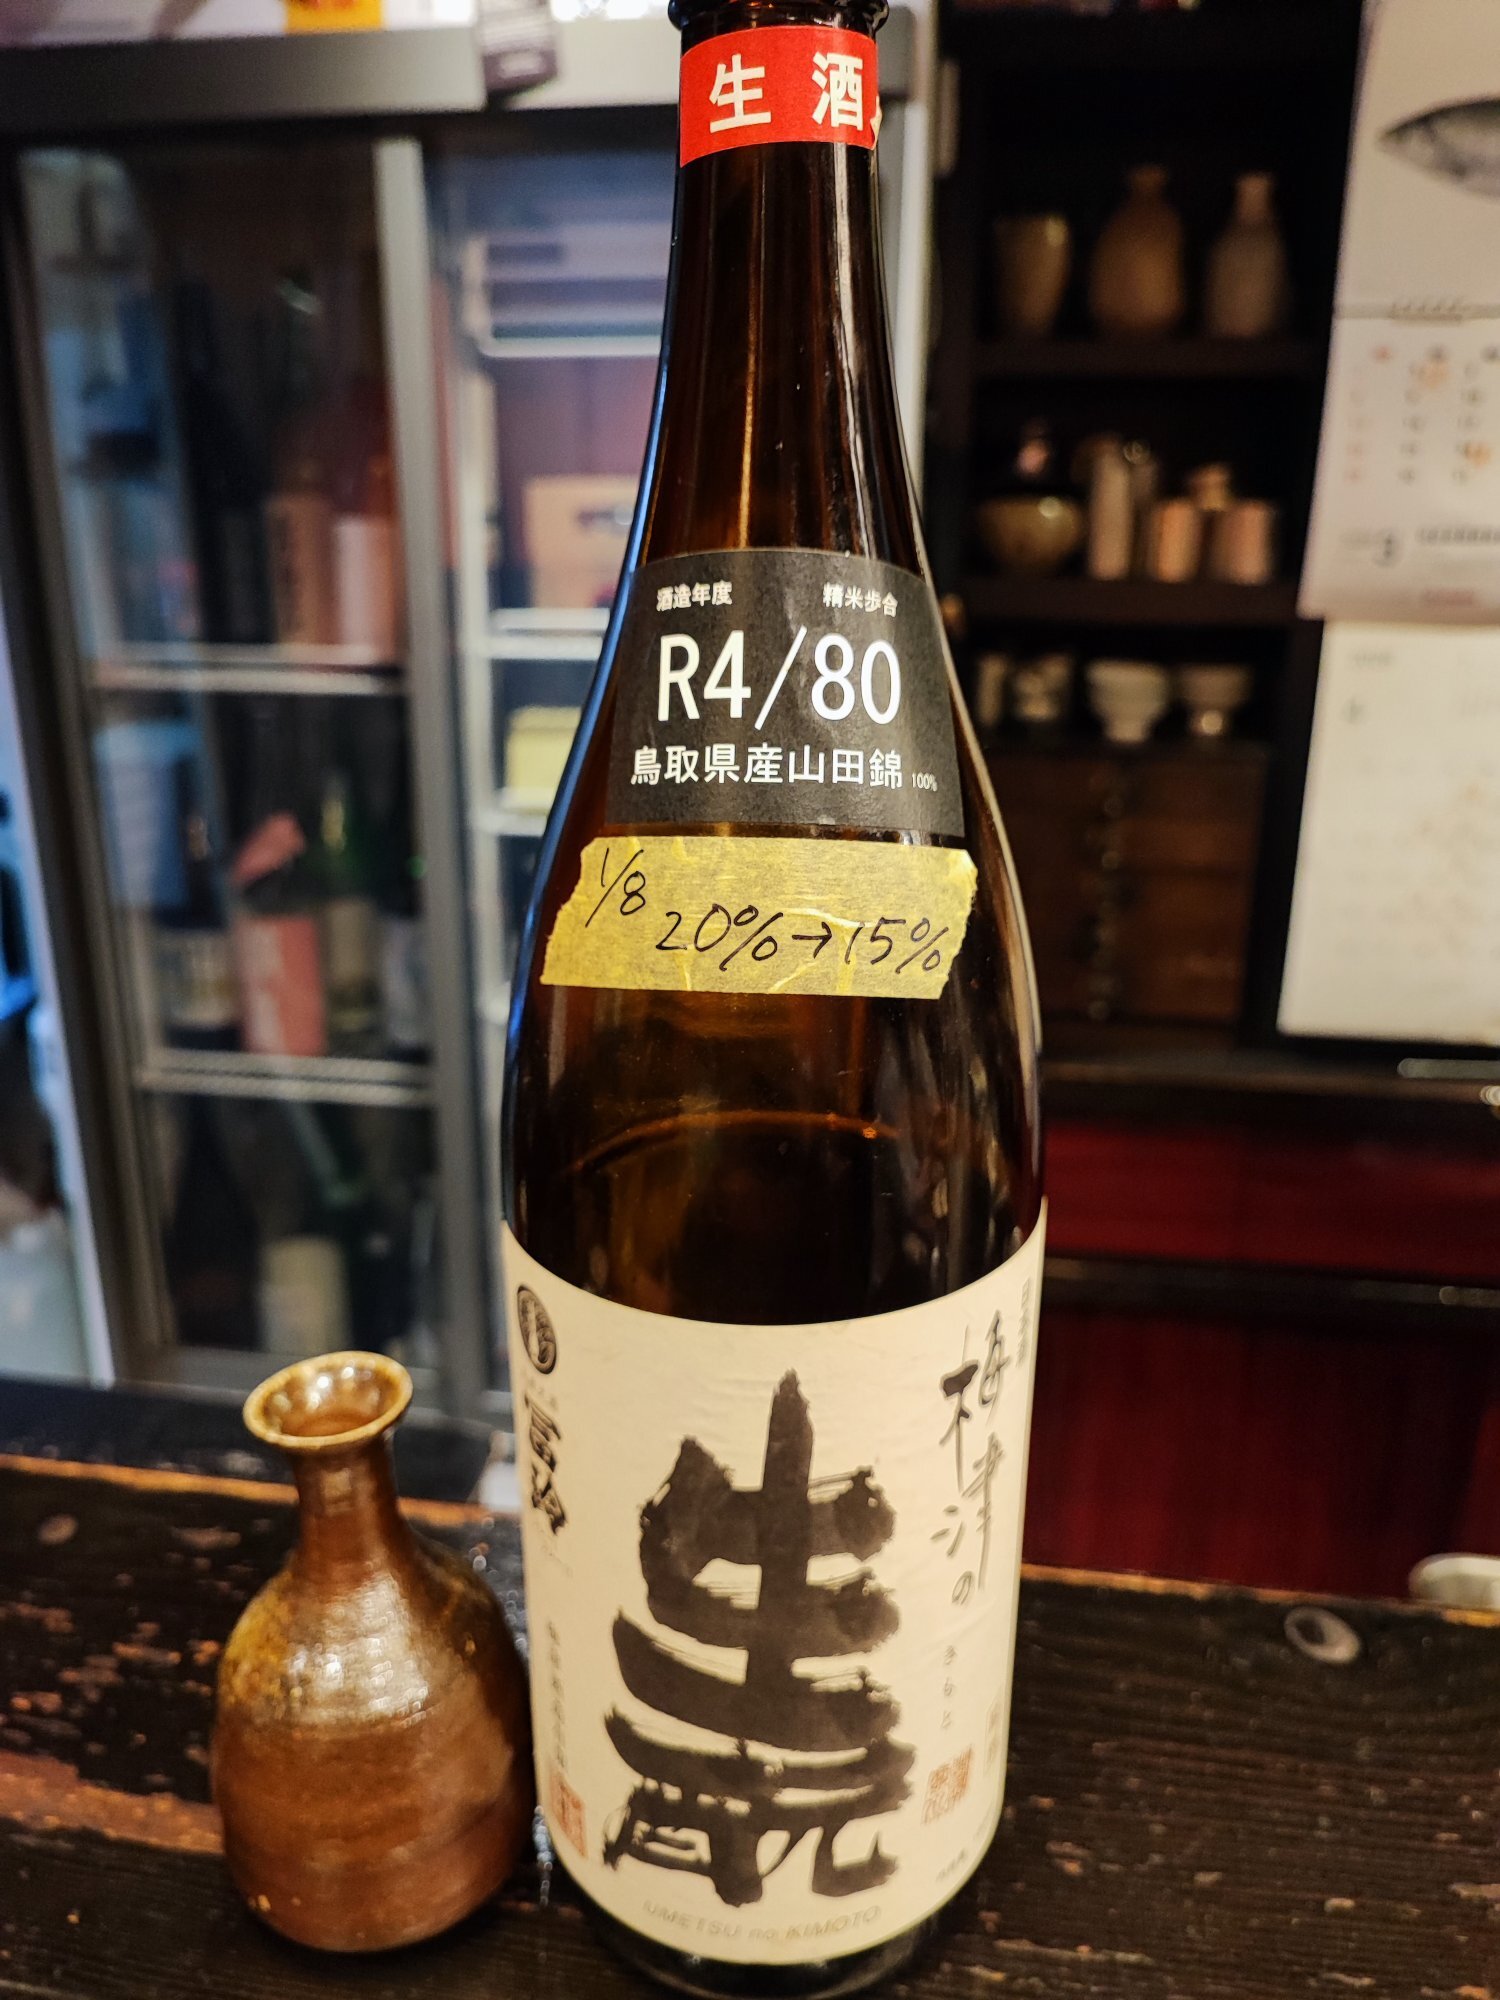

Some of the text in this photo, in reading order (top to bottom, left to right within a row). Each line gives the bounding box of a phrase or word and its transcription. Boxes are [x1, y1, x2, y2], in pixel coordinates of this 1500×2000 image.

[709, 52, 864, 133] 生酒
[656, 580, 733, 611] 酒造年度
[823, 582, 898, 617] 精米歩合
[657, 626, 901, 730] R4/80
[630, 743, 938, 792] 鳥取県産山田錦 100%
[586, 848, 647, 927] 1/8
[641, 1899, 741, 1938] UMETSU
[784, 1904, 883, 1942] KIMOTO
